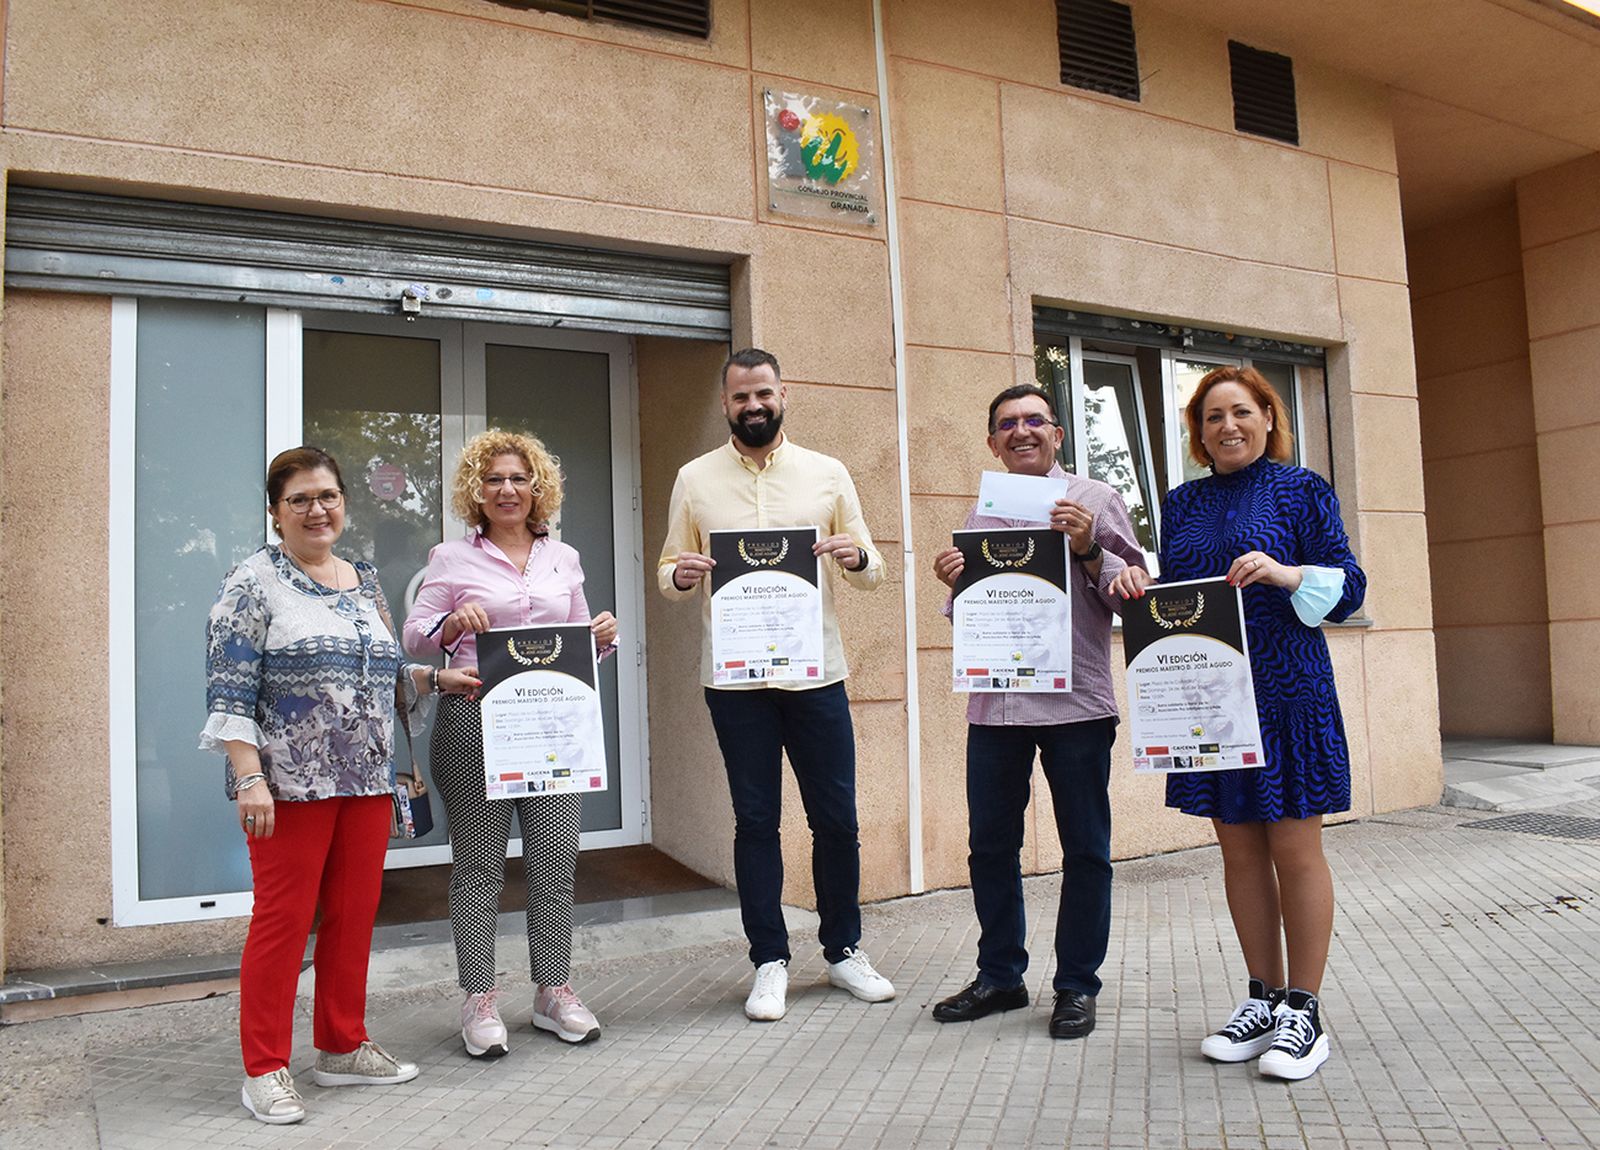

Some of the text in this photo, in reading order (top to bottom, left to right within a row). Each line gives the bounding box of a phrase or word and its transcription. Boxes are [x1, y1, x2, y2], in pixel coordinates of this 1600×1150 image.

[831, 190, 869, 202] PROVINCIAL
[831, 201, 870, 214] GRANADA
[742, 584, 787, 594] VI EDICIÓN
[986, 588, 1034, 598] VI EDICIÓN
[1157, 652, 1207, 665] VI EDICIÓN
[1136, 666, 1159, 674] PREMIOS
[1160, 664, 1185, 672] MAESTRO
[1194, 660, 1209, 669] JOSÉ
[514, 687, 563, 697] VI EDICIÓN
